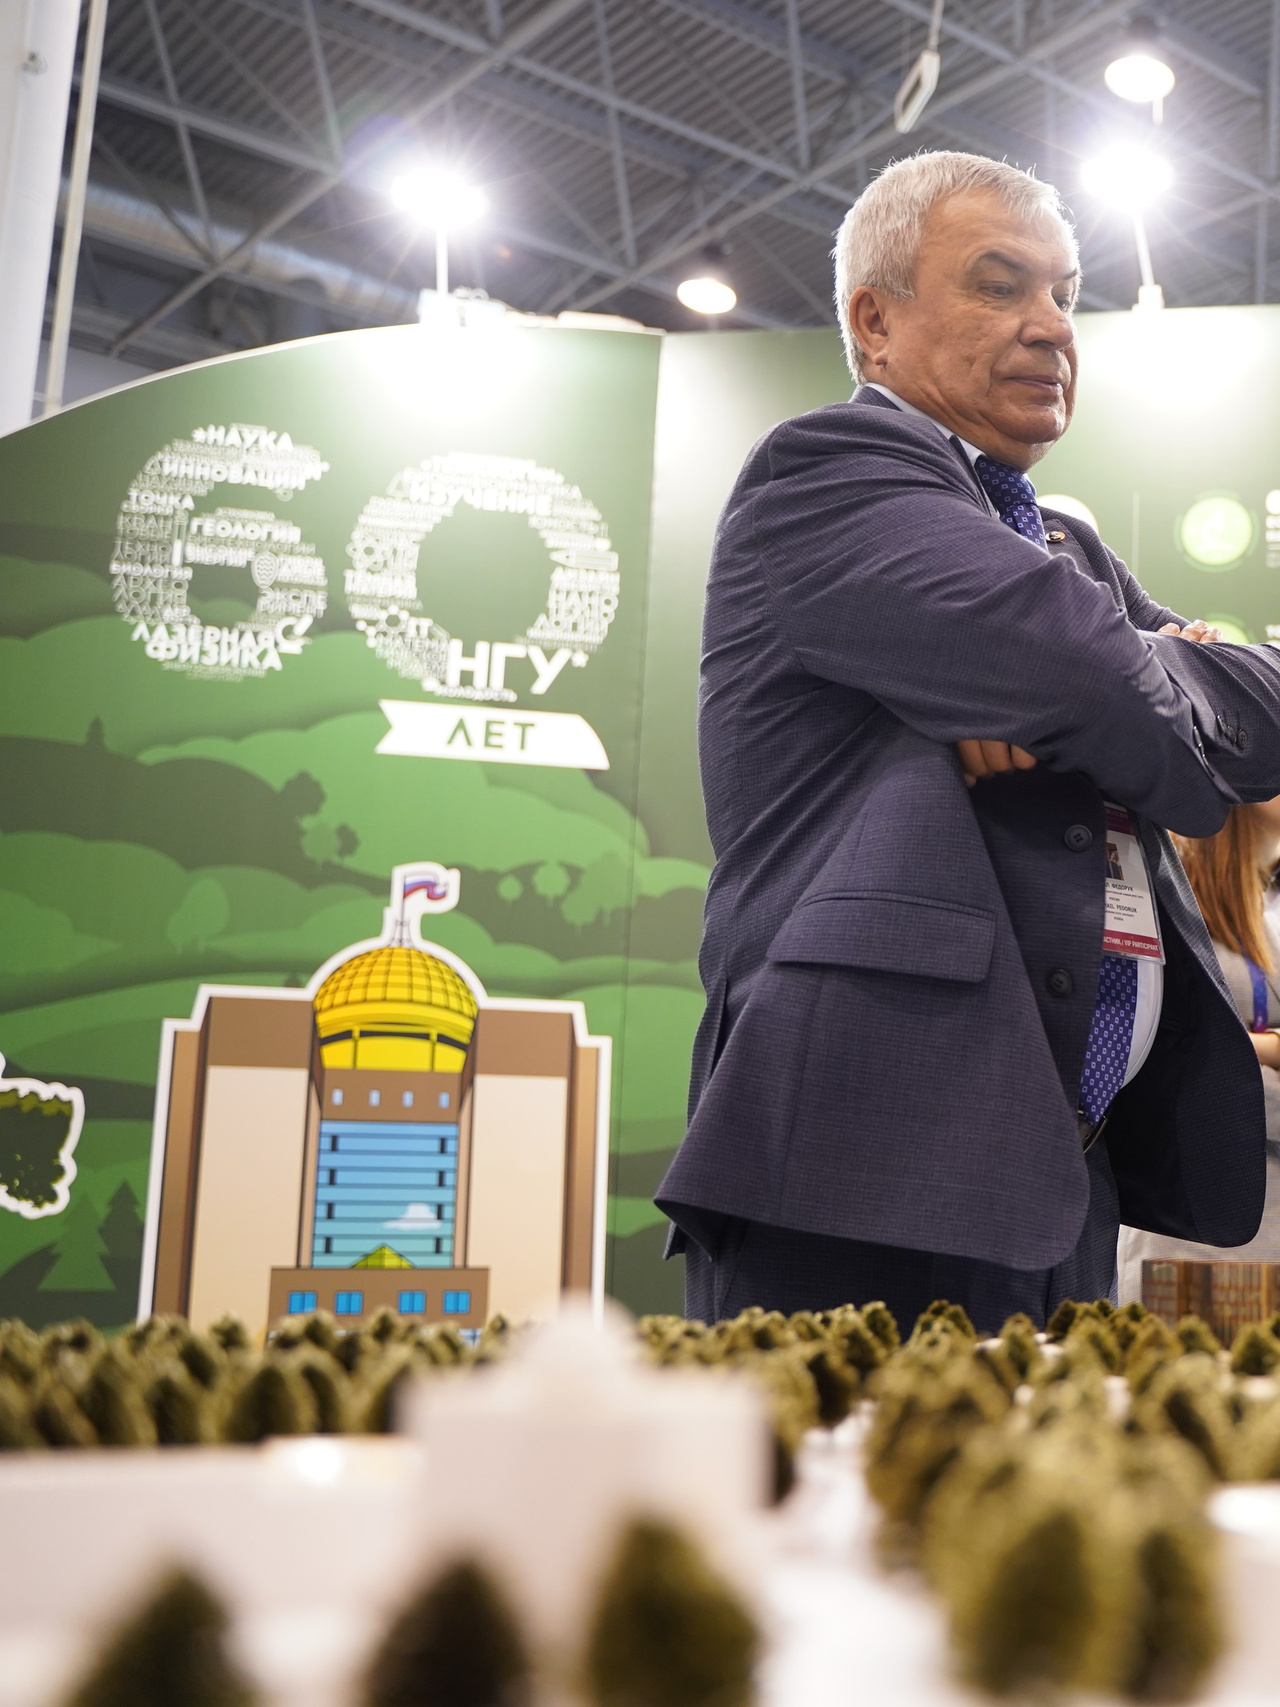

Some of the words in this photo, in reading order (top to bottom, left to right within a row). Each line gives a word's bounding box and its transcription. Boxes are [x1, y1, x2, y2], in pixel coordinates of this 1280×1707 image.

[208, 424, 294, 451] НАУКА
[128, 488, 195, 511] ТОЧКА
[411, 480, 551, 515] ИЗУЧЕНИЕ
[131, 621, 276, 648] ЛАЗЕРНАЯ
[145, 641, 283, 671] ФИЗИКА
[447, 638, 574, 695] НГУ
[447, 717, 536, 751] ЛЕТ
[1103, 936, 1121, 945] АСТНИК
